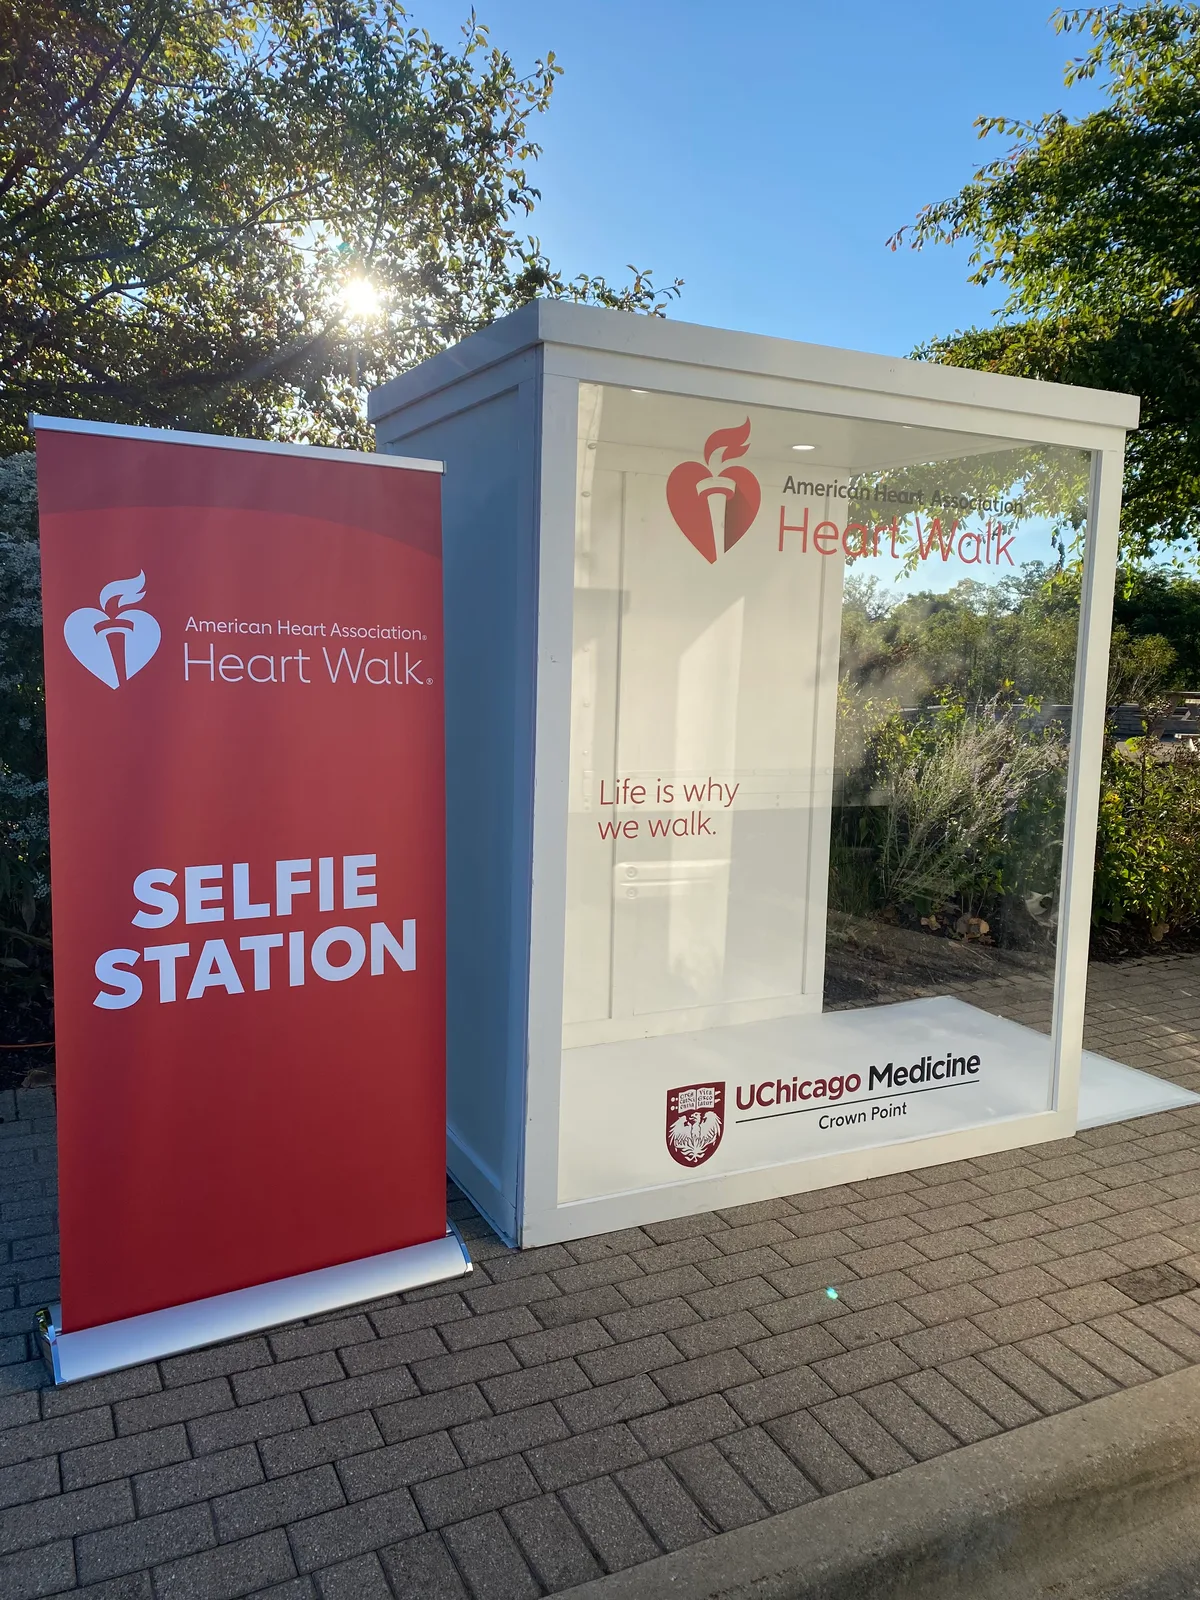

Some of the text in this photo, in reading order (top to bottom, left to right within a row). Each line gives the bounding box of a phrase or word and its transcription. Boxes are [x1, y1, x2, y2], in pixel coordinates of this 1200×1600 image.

[783, 475, 1023, 514] American Heart Association
[778, 505, 1016, 566] Heart Walk
[185, 616, 272, 635] American
[277, 620, 327, 637] Heart
[184, 642, 311, 684] Heart
[600, 776, 740, 808] Life is why
[597, 810, 717, 840] we walk.
[131, 853, 378, 929] SELFIE
[92, 918, 417, 1010] STATION
[736, 1072, 862, 1111] UChicago
[868, 1052, 981, 1091] Medicine
[818, 1101, 908, 1130] Crown Point
